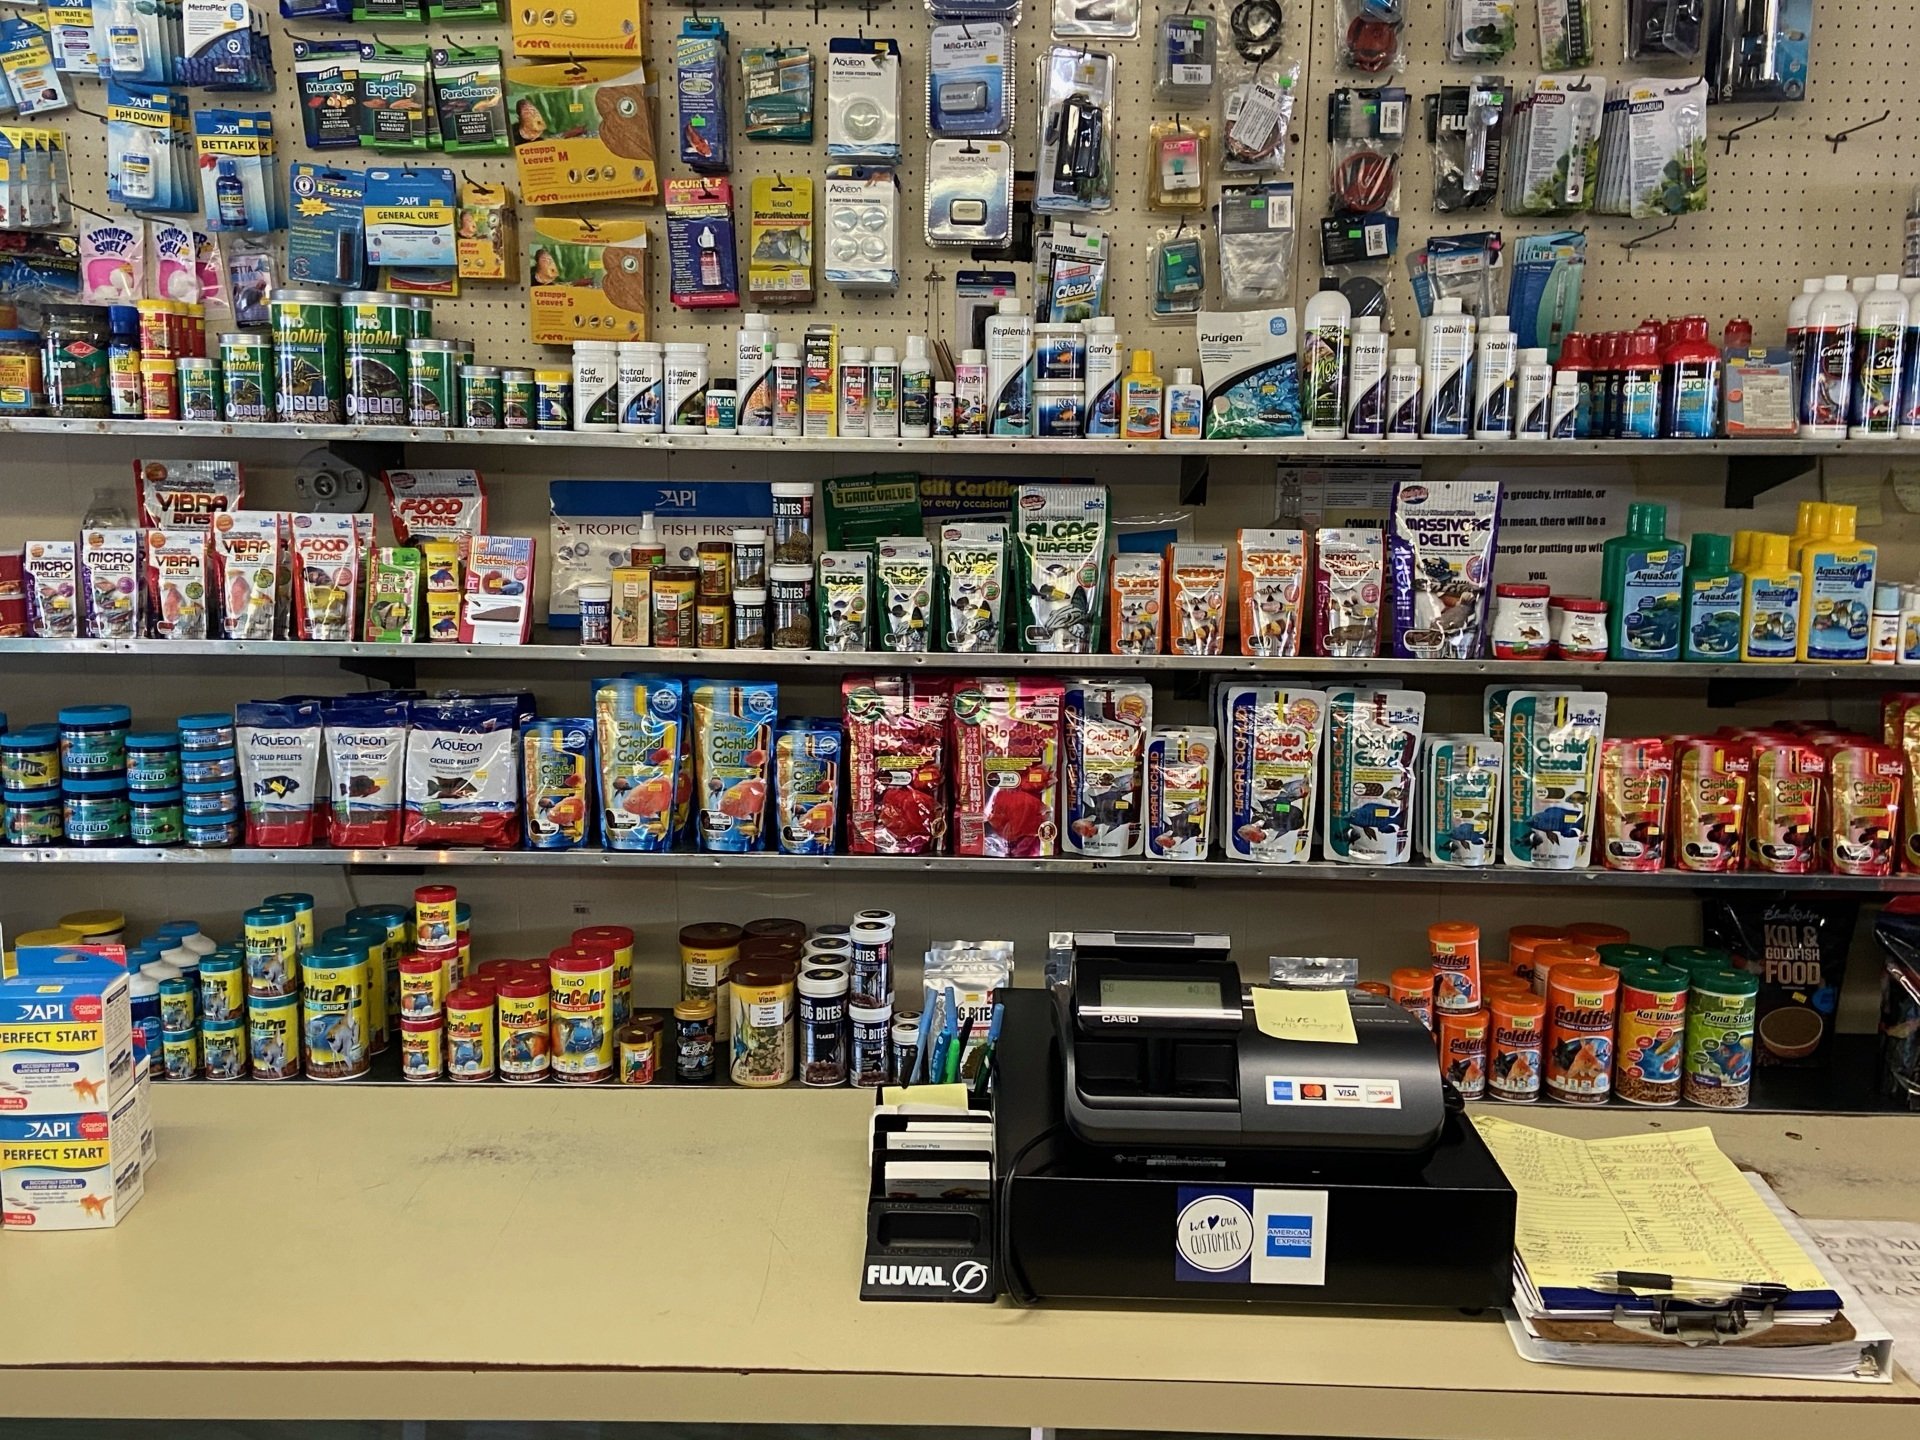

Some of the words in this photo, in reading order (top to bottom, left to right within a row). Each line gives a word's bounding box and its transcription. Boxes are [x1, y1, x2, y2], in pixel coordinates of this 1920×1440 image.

[188, 3, 227, 12] MetroPlex
[523, 40, 551, 49] sera
[318, 66, 341, 81] FRITZ
[380, 70, 402, 83] FRITZ
[458, 72, 479, 86] FRITZ
[306, 82, 354, 95] Maracyn
[366, 82, 417, 98] Expel-P
[441, 86, 501, 99] ParaCleanse
[1255, 84, 1277, 100] FLUVAL
[129, 97, 152, 108] API
[1536, 95, 1565, 104] AQUARIUM
[1632, 102, 1664, 113] AQUARIUM
[134, 112, 164, 123] DOWN
[215, 125, 239, 134] API
[201, 139, 256, 151] BETTAFIX
[519, 146, 556, 157] Catappa
[523, 155, 554, 165] Leaves
[317, 183, 363, 199] Eggs
[396, 196, 419, 206] API
[377, 211, 415, 221] GENERAL
[417, 211, 440, 220] CURE
[754, 211, 811, 220] TetraWeekend
[95, 241, 126, 256] SHELL
[159, 240, 181, 256] SHELL
[1532, 244, 1553, 253] Aqua
[1530, 251, 1556, 260] LIFE
[1056, 276, 1099, 299] ClearX
[993, 327, 1031, 337] Replenish
[1201, 333, 1243, 345] Purigen
[739, 345, 761, 353] Garlic
[740, 352, 762, 361] Guard
[580, 368, 596, 376] Acid
[580, 375, 604, 384] Buffer
[668, 377, 691, 386] Buffer
[920, 481, 952, 496] Gift
[656, 490, 697, 507] API
[1510, 490, 1552, 500] grouchy,
[1553, 489, 1594, 499] irritable,
[1596, 490, 1606, 498] or
[155, 493, 228, 513] VIBRA
[401, 499, 463, 515] FOOD
[780, 502, 802, 515] BITES
[935, 500, 961, 510] every
[963, 499, 1009, 509] occasion!
[173, 513, 212, 525] BITES
[410, 515, 457, 527] STICKS
[1509, 518, 1538, 527] mean,
[1540, 517, 1565, 526] there
[1567, 517, 1584, 526] will
[1586, 517, 1597, 526] be
[1599, 518, 1606, 526] a
[662, 524, 697, 536] FISH
[1405, 518, 1491, 532] MASSIVORE
[1025, 522, 1099, 541] ALGAE
[300, 540, 348, 551] FOOD
[1419, 533, 1470, 547] DELITE
[223, 541, 271, 554] VIBRA
[1036, 542, 1093, 553] WAFERS
[1524, 544, 1538, 553] for
[1539, 544, 1573, 554] putting
[1575, 545, 1587, 554] up
[88, 552, 134, 563] MICRO
[155, 556, 199, 568] VIBRA
[235, 554, 259, 562] BITES
[307, 552, 342, 561] STICKS
[947, 552, 998, 564] ALGAE
[30, 561, 73, 571] MICRO
[94, 563, 131, 571] PELLETS
[166, 567, 190, 575] BITES
[36, 571, 71, 579] PELLETS
[825, 576, 864, 585] ALGAE
[1528, 572, 1547, 580] you.
[1634, 571, 1677, 581] AquaSafe
[782, 587, 803, 598] BITES
[1699, 592, 1738, 602] AquaSafe
[713, 722, 747, 735] Sinking
[618, 735, 662, 748] Cichlid
[713, 736, 755, 750] Cichlid
[67, 755, 107, 764] CICHLID
[430, 757, 456, 765] CICHLID
[457, 756, 480, 764] PELLETS
[617, 750, 648, 763] Gold
[712, 751, 740, 764] Gold
[1535, 756, 1582, 771] Excel
[127, 772, 166, 781] CICHLID
[793, 781, 817, 792] Gold
[1700, 778, 1738, 790] Cichlid
[68, 823, 109, 832] CICHLID
[1764, 925, 1799, 947] KOI
[1803, 926, 1819, 947] &
[1765, 948, 1820, 961] GOLDFISH
[1766, 961, 1821, 985] FOOD
[17, 1004, 65, 1021] API
[322, 1003, 345, 1011] CRISPS
[800, 1006, 814, 1019] BUG
[816, 1004, 842, 1020] BITES
[1102, 1015, 1139, 1024] CASIO
[1637, 1009, 1652, 1020] Koi
[1704, 1012, 1730, 1022] Pond
[56, 1030, 98, 1042] START
[854, 1028, 867, 1039] BUG
[868, 1028, 888, 1039] BITES
[1338, 1089, 1357, 1097] VISA
[24, 1123, 71, 1138] API
[4, 1149, 58, 1161] PERFECT
[64, 1147, 104, 1160] START
[1190, 1231, 1242, 1255] CUSTOMERS
[867, 1265, 950, 1287] FLUVAL
